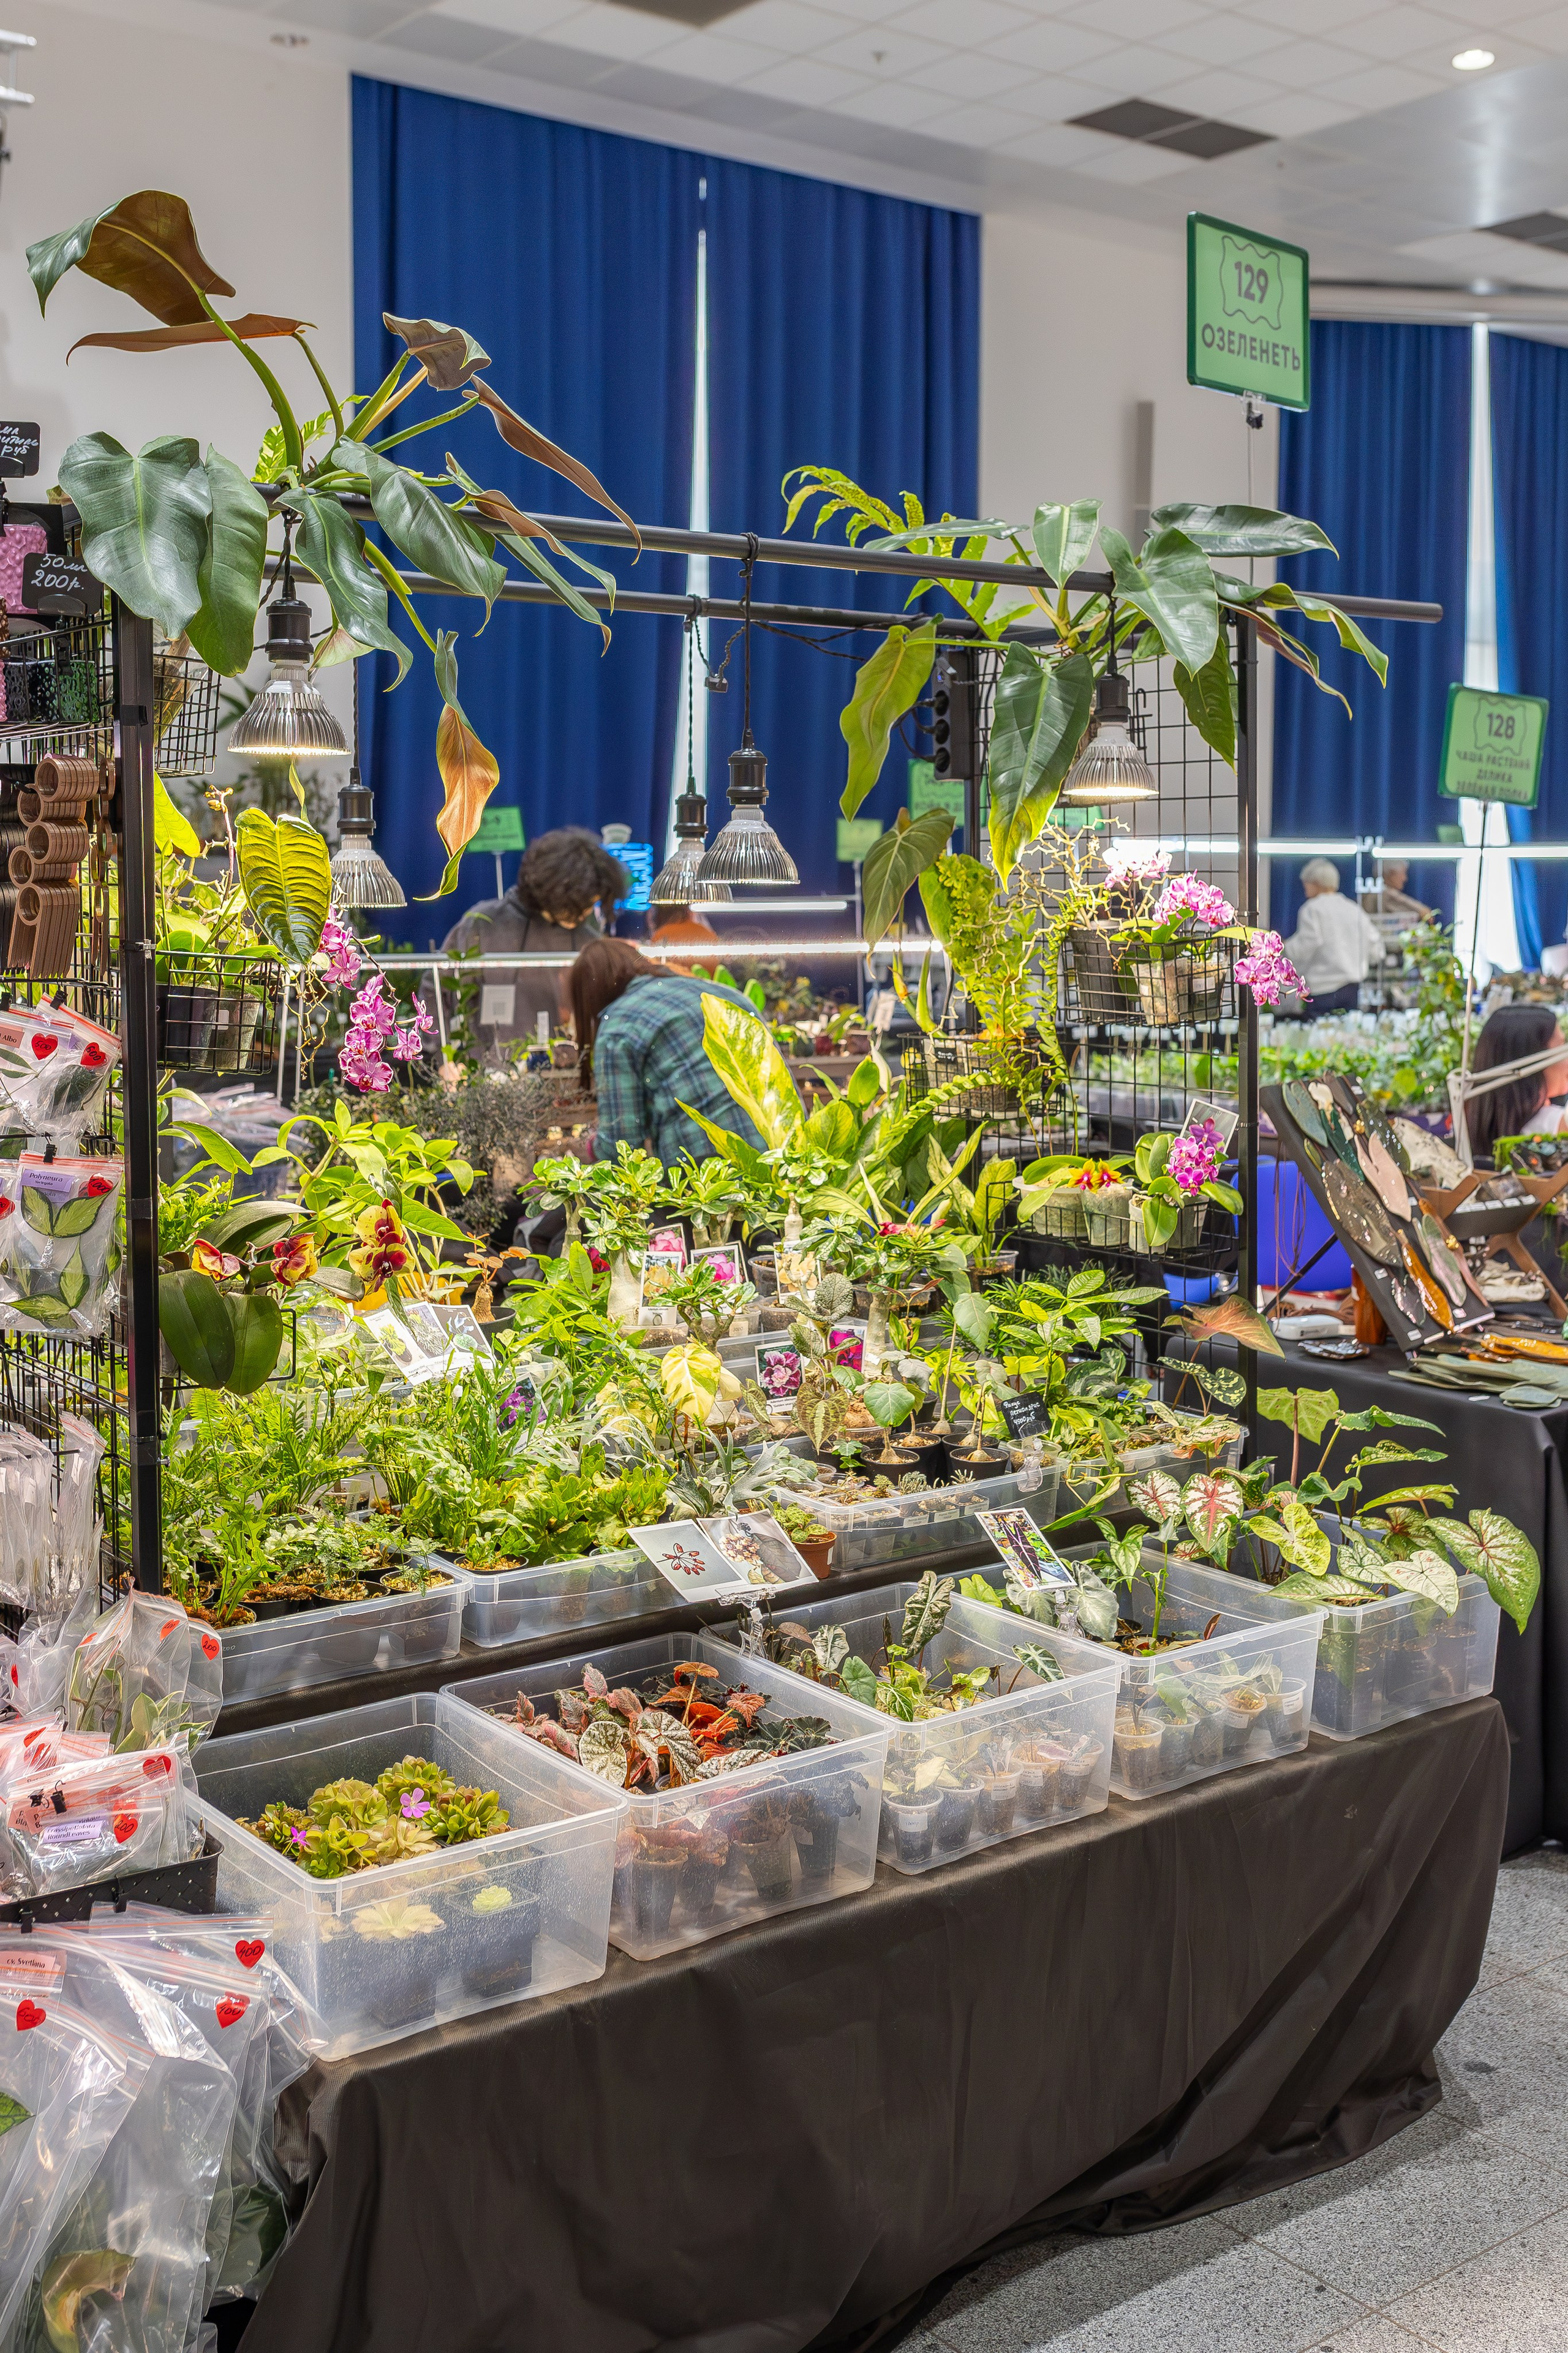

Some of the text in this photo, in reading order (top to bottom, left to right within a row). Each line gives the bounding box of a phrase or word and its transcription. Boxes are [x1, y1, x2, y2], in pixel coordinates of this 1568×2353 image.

[1234, 260, 1269, 304] 129
[1201, 322, 1301, 372] ОЗЕЛЕНЕТЬ
[1487, 712, 1515, 739] 128
[3, 1035, 17, 1043] Albo
[34, 1041, 51, 1051] 500
[86, 1046, 102, 1061] 600
[29, 1172, 63, 1182] Polyneura
[203, 1641, 217, 1652] 200
[115, 1820, 135, 1833] 200
[239, 1945, 262, 1958] 400
[219, 2004, 241, 2015] 400
